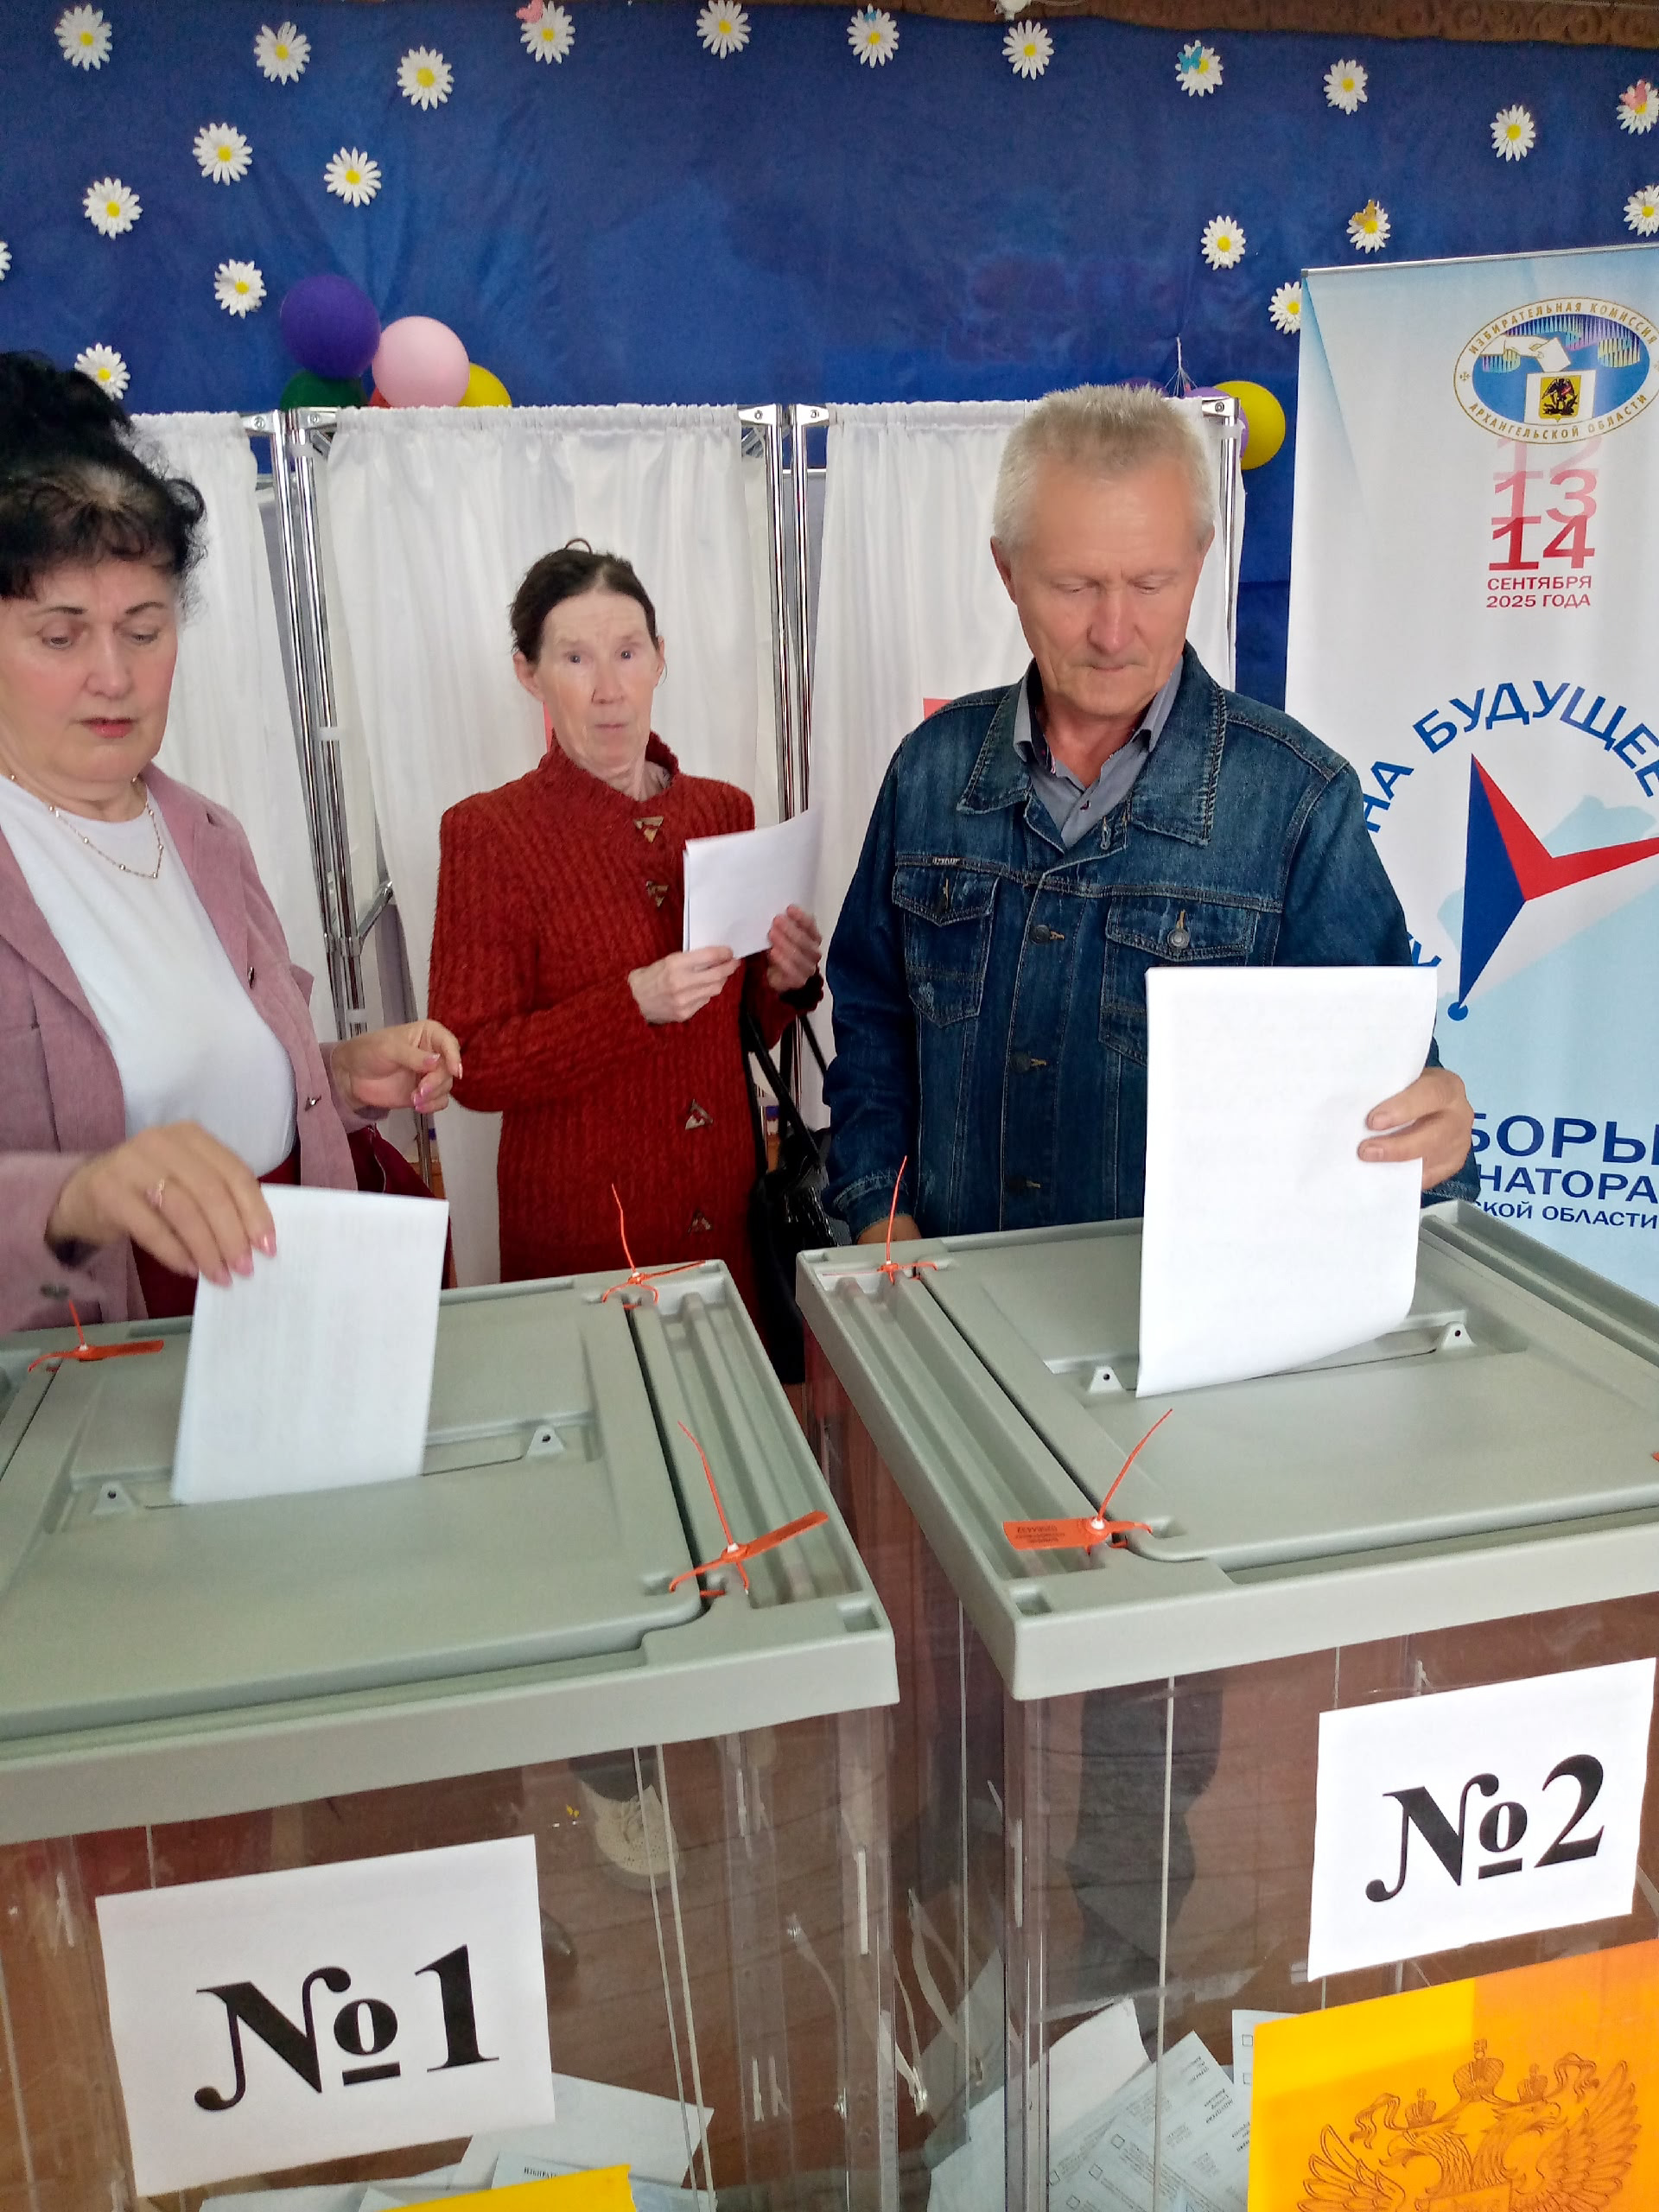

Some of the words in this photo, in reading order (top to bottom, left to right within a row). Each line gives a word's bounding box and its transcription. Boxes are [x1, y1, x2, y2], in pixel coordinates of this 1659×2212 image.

[1470, 302, 1582, 354] ИЗБИРАТЕЛЬНАЯ
[1590, 302, 1657, 344] КОМИССИЯ
[1469, 403, 1580, 440] АРХАНГЕЛЬСКОЙ
[1588, 394, 1647, 432] ОБЛАСТИ
[1491, 469, 1598, 524] 13
[1489, 515, 1595, 570] 14
[1486, 594, 1536, 607] 2025
[1543, 594, 1591, 608] ГОДА
[1487, 575, 1592, 590] СЕНТЯБРЯ
[1475, 1202, 1533, 1219] КОЙ
[1542, 1205, 1658, 1229] ОБЛАСТИ
